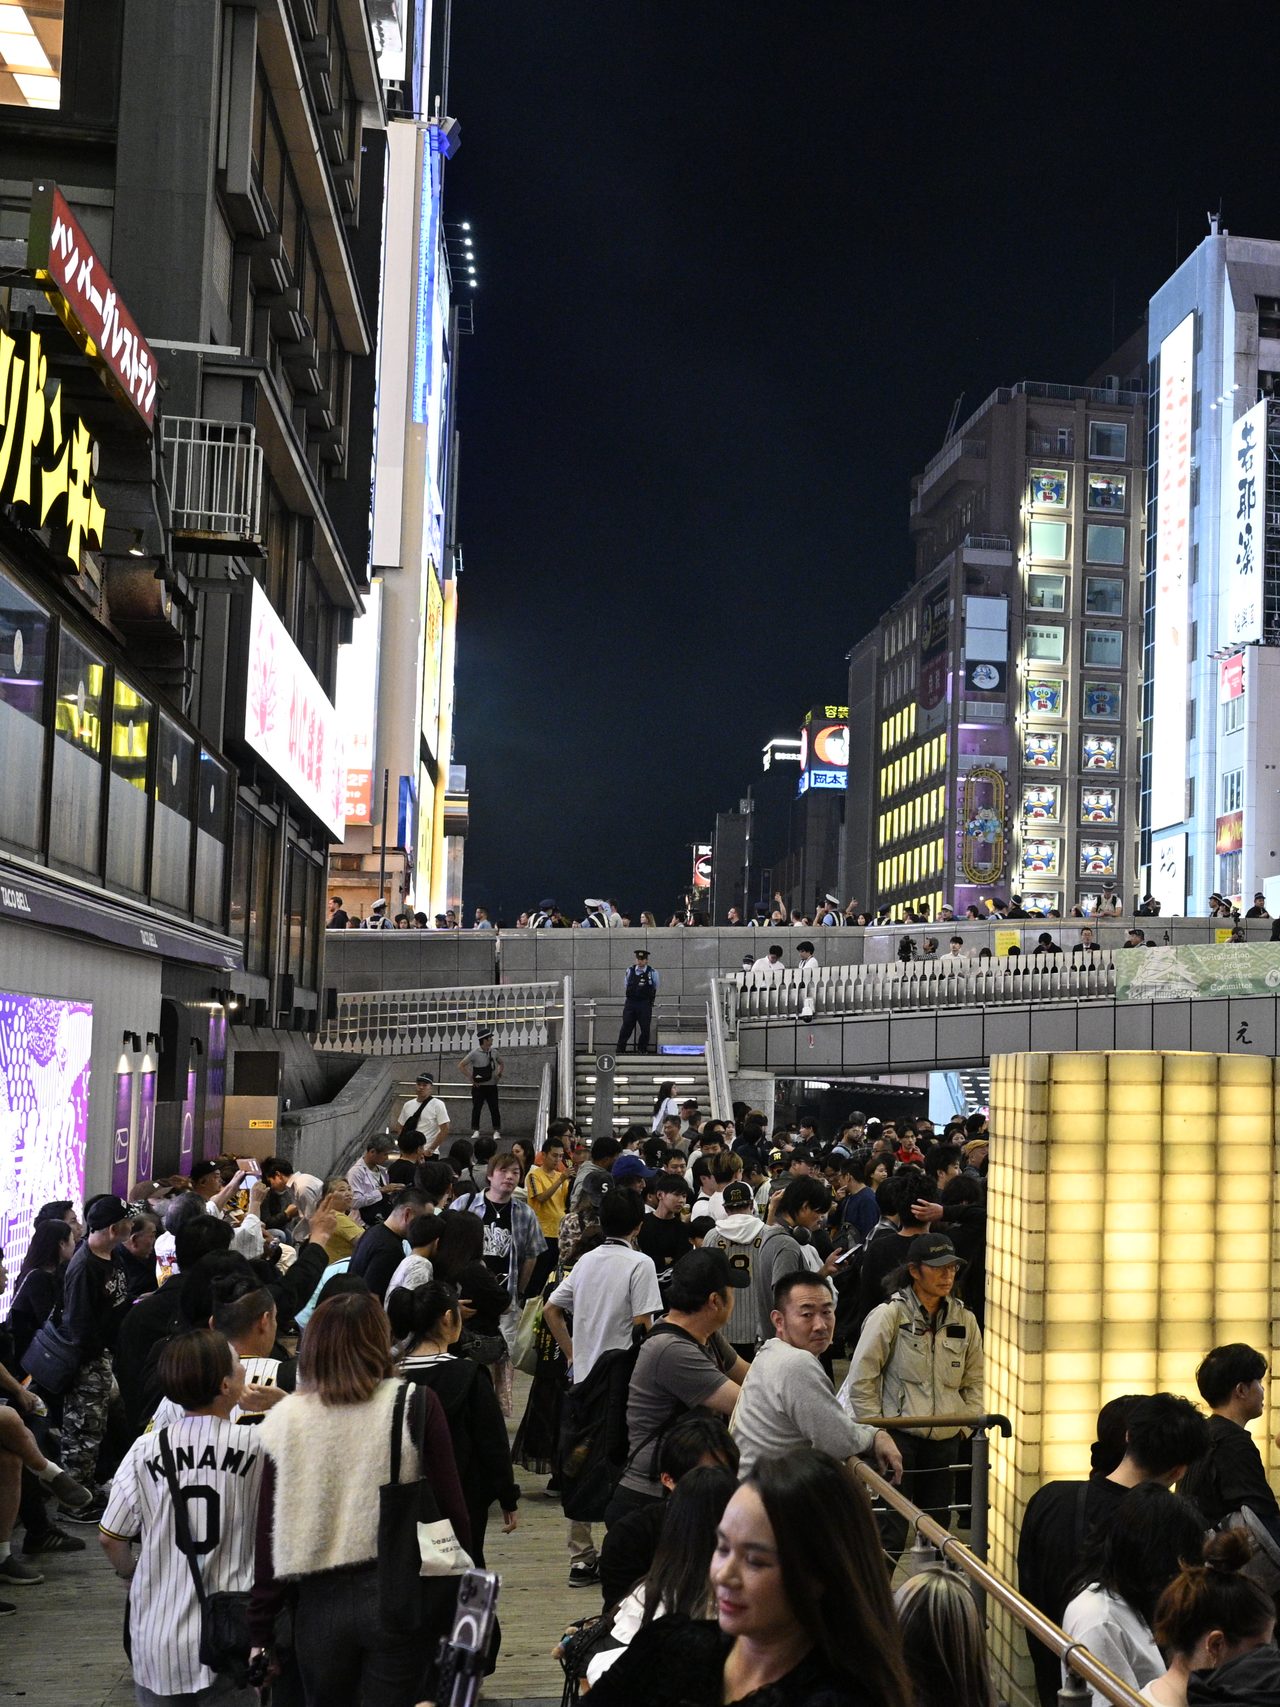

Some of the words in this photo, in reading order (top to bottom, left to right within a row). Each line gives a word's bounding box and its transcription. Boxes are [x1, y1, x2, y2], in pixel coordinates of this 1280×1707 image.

[52, 217, 156, 413] ハンバーグレストラン
[146, 1445, 256, 1483] KNAMI
[175, 1485, 220, 1555] 0
